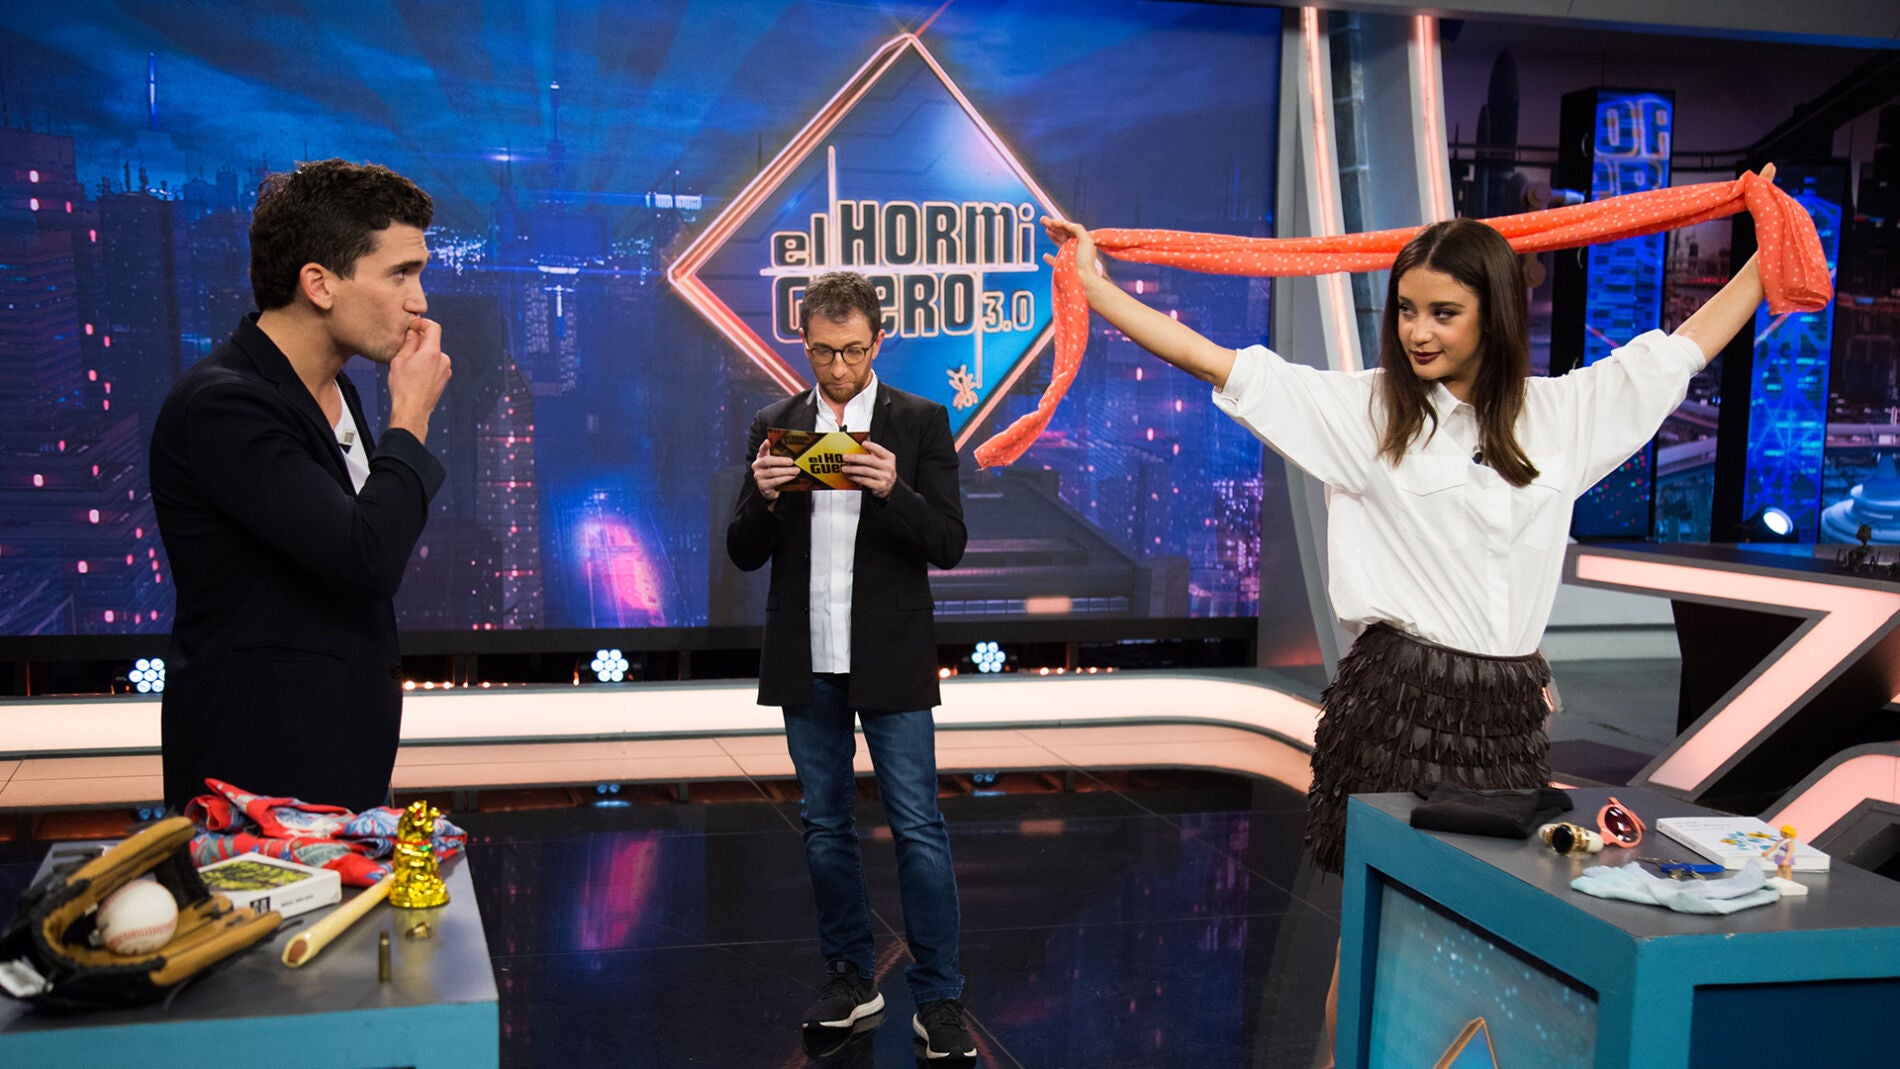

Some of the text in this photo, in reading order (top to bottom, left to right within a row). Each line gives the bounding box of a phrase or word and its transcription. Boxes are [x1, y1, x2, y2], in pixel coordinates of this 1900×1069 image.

[770, 213, 829, 267] el
[982, 291, 1035, 332] 3.0
[824, 453, 845, 463] HO
